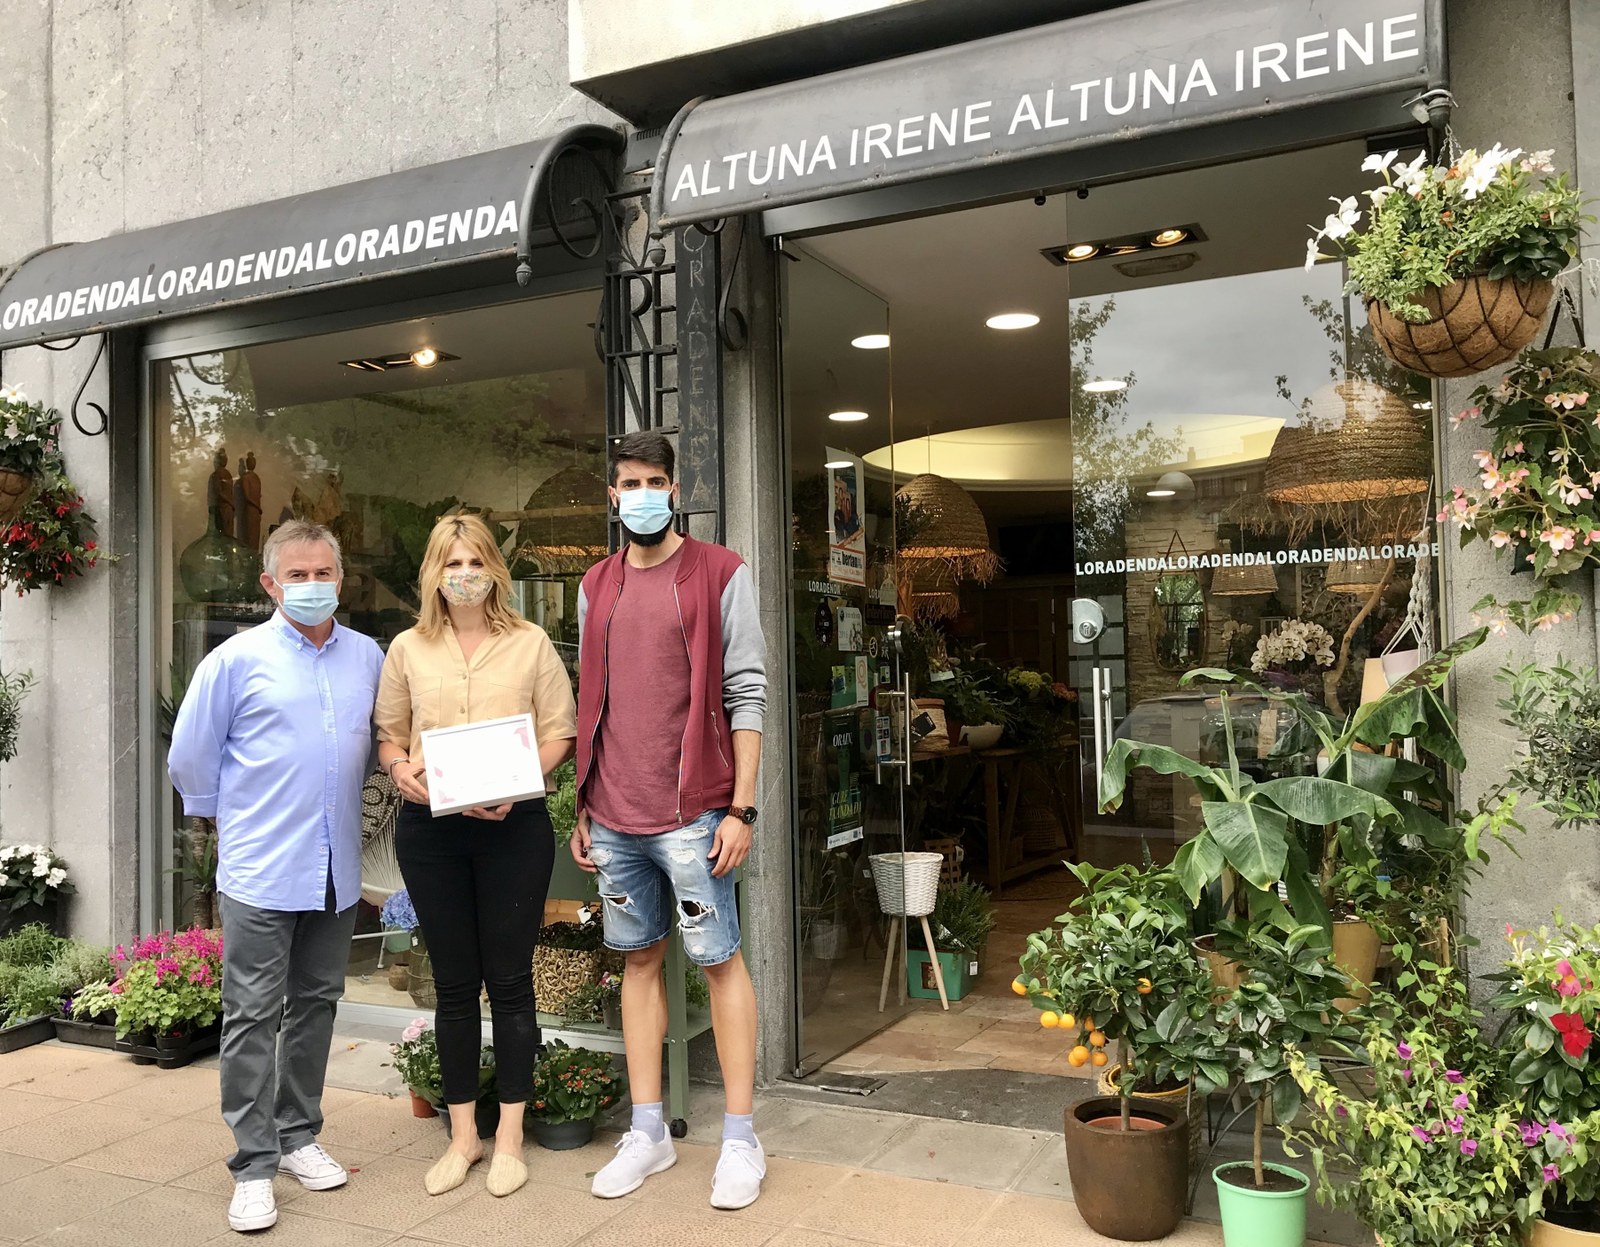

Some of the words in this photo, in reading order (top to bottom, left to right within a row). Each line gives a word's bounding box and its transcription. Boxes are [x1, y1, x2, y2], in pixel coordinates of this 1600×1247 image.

[670, 135, 837, 202] ALTUNA
[850, 101, 993, 166] IRENE
[1008, 58, 1218, 135] ALTUNA
[1236, 12, 1419, 92] IRENE
[0, 201, 519, 331] ORADENDALORADENDALORADENDA
